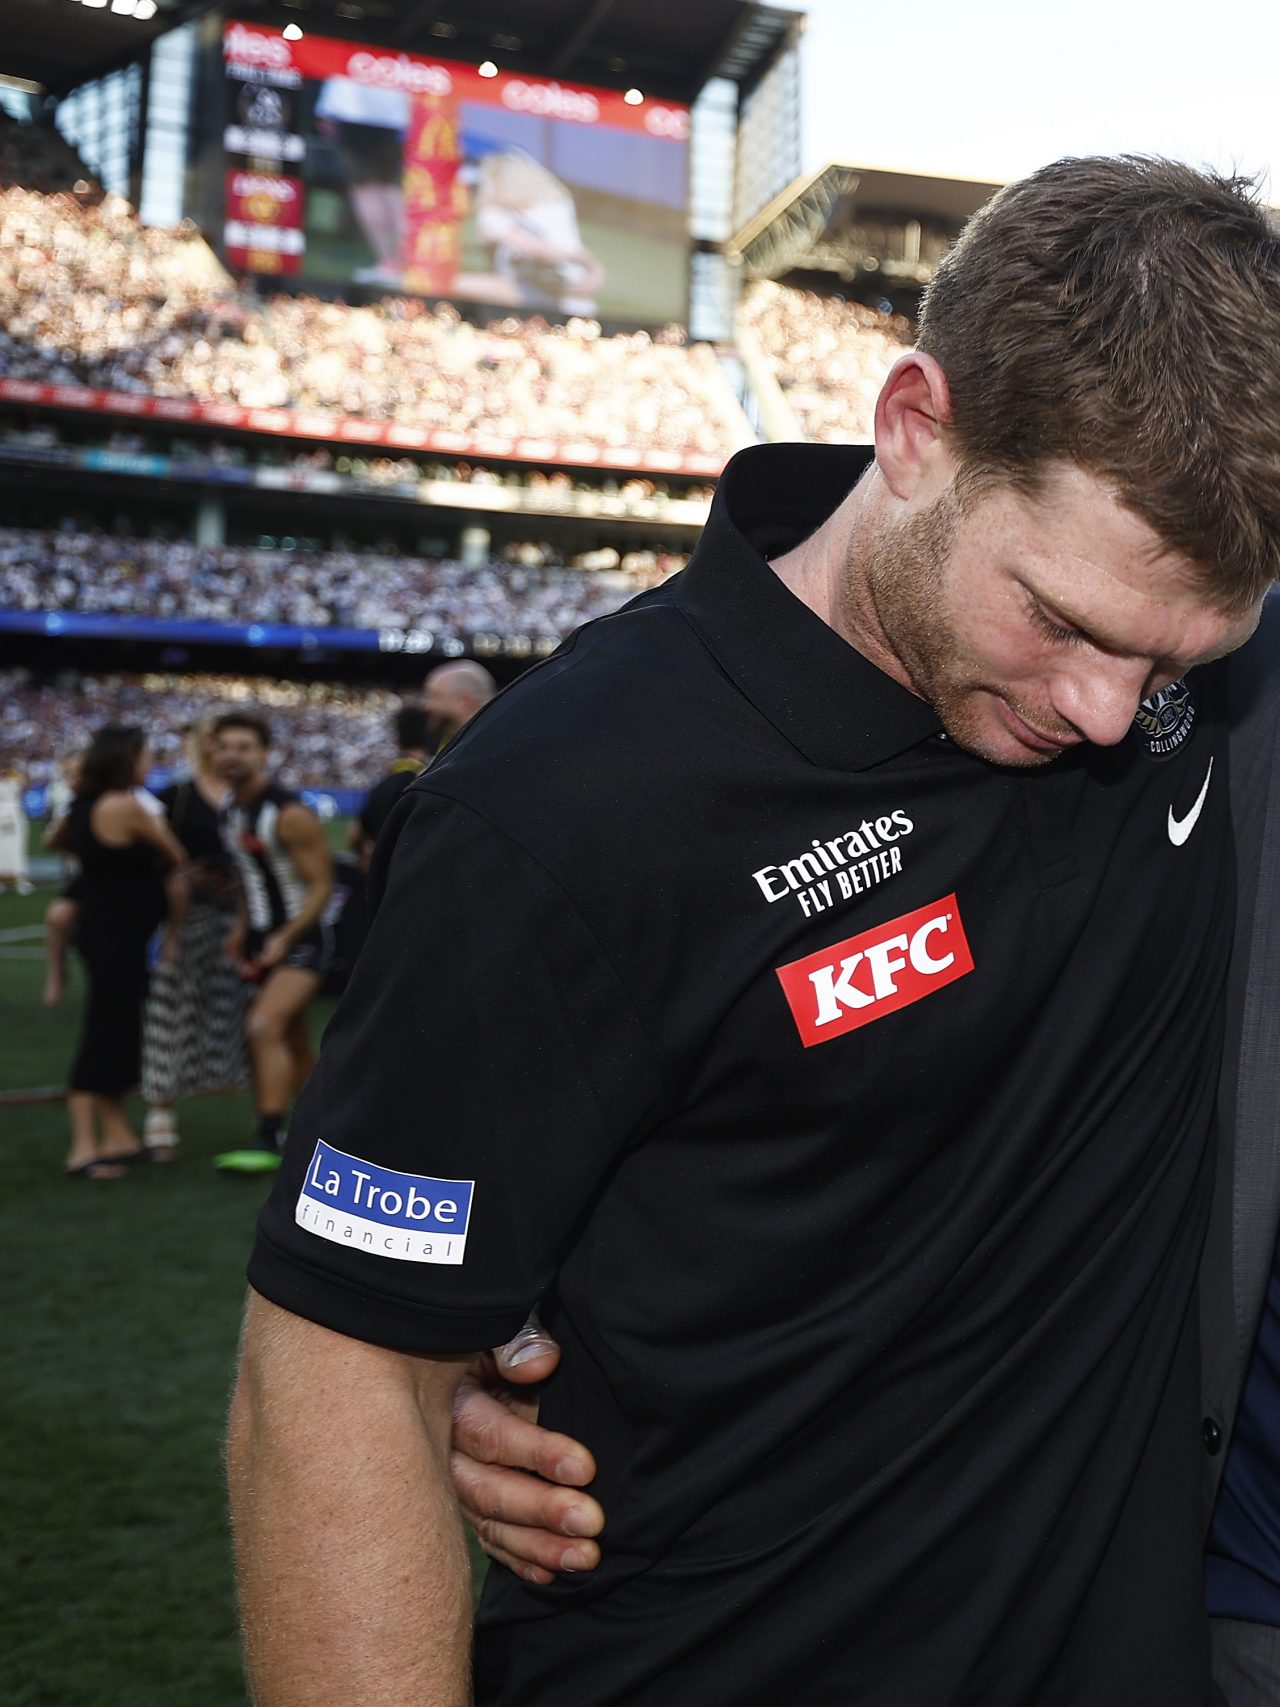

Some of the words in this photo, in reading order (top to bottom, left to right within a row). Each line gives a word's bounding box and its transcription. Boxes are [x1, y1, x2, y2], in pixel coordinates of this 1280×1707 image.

[1150, 705, 1195, 752] COLLINGWOOD
[752, 809, 914, 903] Emirates
[797, 879, 834, 918] FLY
[836, 846, 903, 900] BETTER
[808, 914, 955, 1027] KFC
[311, 1154, 341, 1196] La
[351, 1169, 457, 1223] Trobe
[302, 1204, 453, 1257] financial
